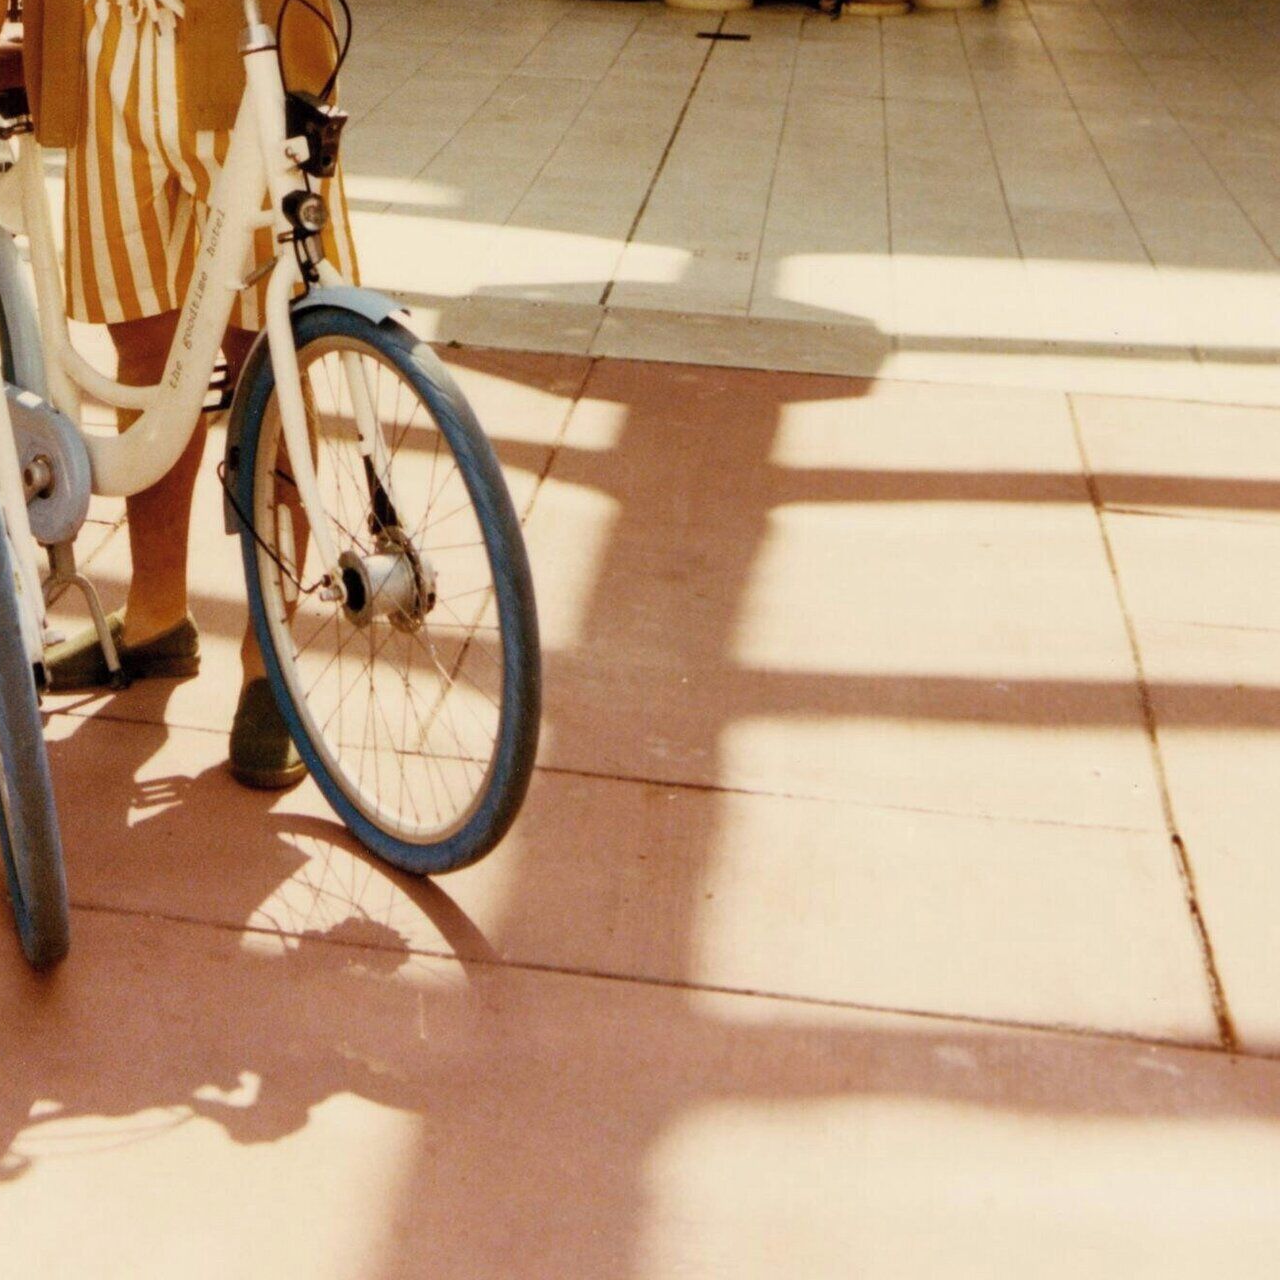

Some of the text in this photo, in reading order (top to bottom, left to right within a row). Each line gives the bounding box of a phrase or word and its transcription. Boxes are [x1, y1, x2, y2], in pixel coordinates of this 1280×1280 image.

[170, 210, 226, 389] the goodtime hotel
